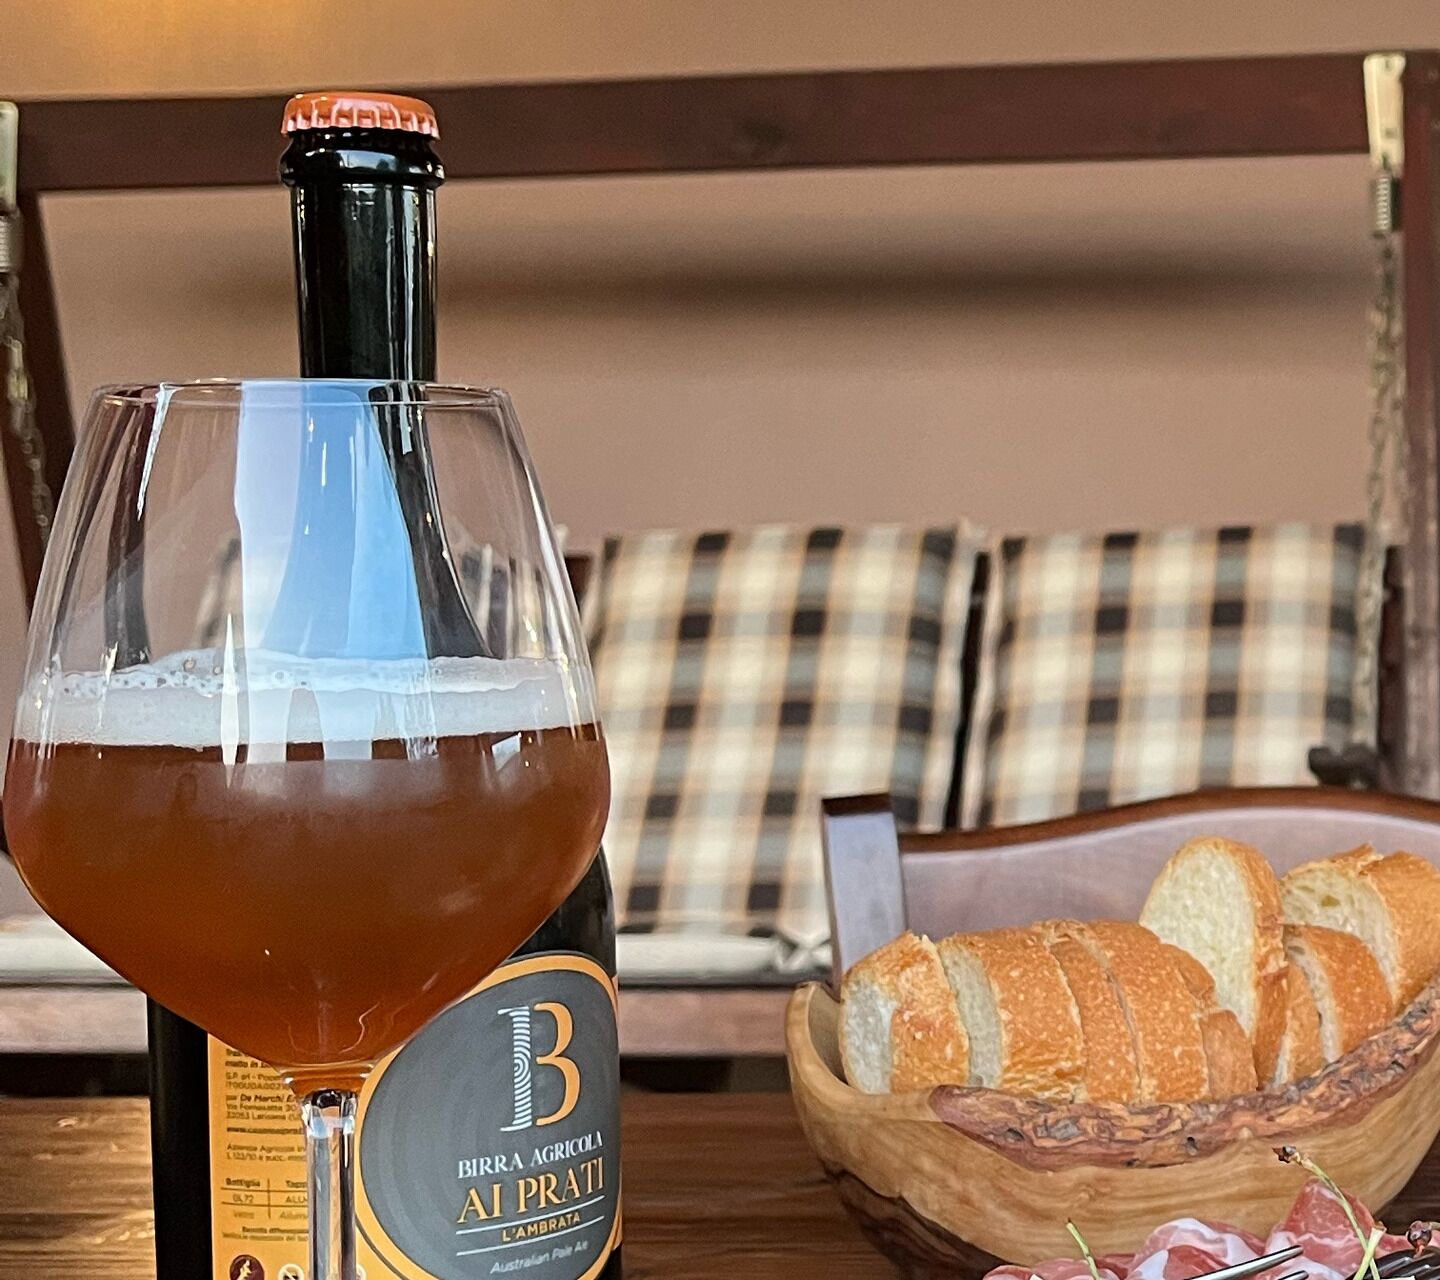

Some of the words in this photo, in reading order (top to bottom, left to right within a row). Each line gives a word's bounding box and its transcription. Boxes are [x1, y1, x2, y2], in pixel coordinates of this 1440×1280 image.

[497, 1000, 582, 1132] B
[457, 1152, 524, 1179] BIRRA
[530, 1130, 604, 1168] AGRICOLA
[456, 1182, 504, 1225] AI
[516, 1156, 605, 1214] PRATI
[502, 1211, 582, 1242] L'AMBRATA
[489, 1251, 550, 1274] Australian
[551, 1243, 574, 1261] Pale
[574, 1239, 590, 1253] Ale
